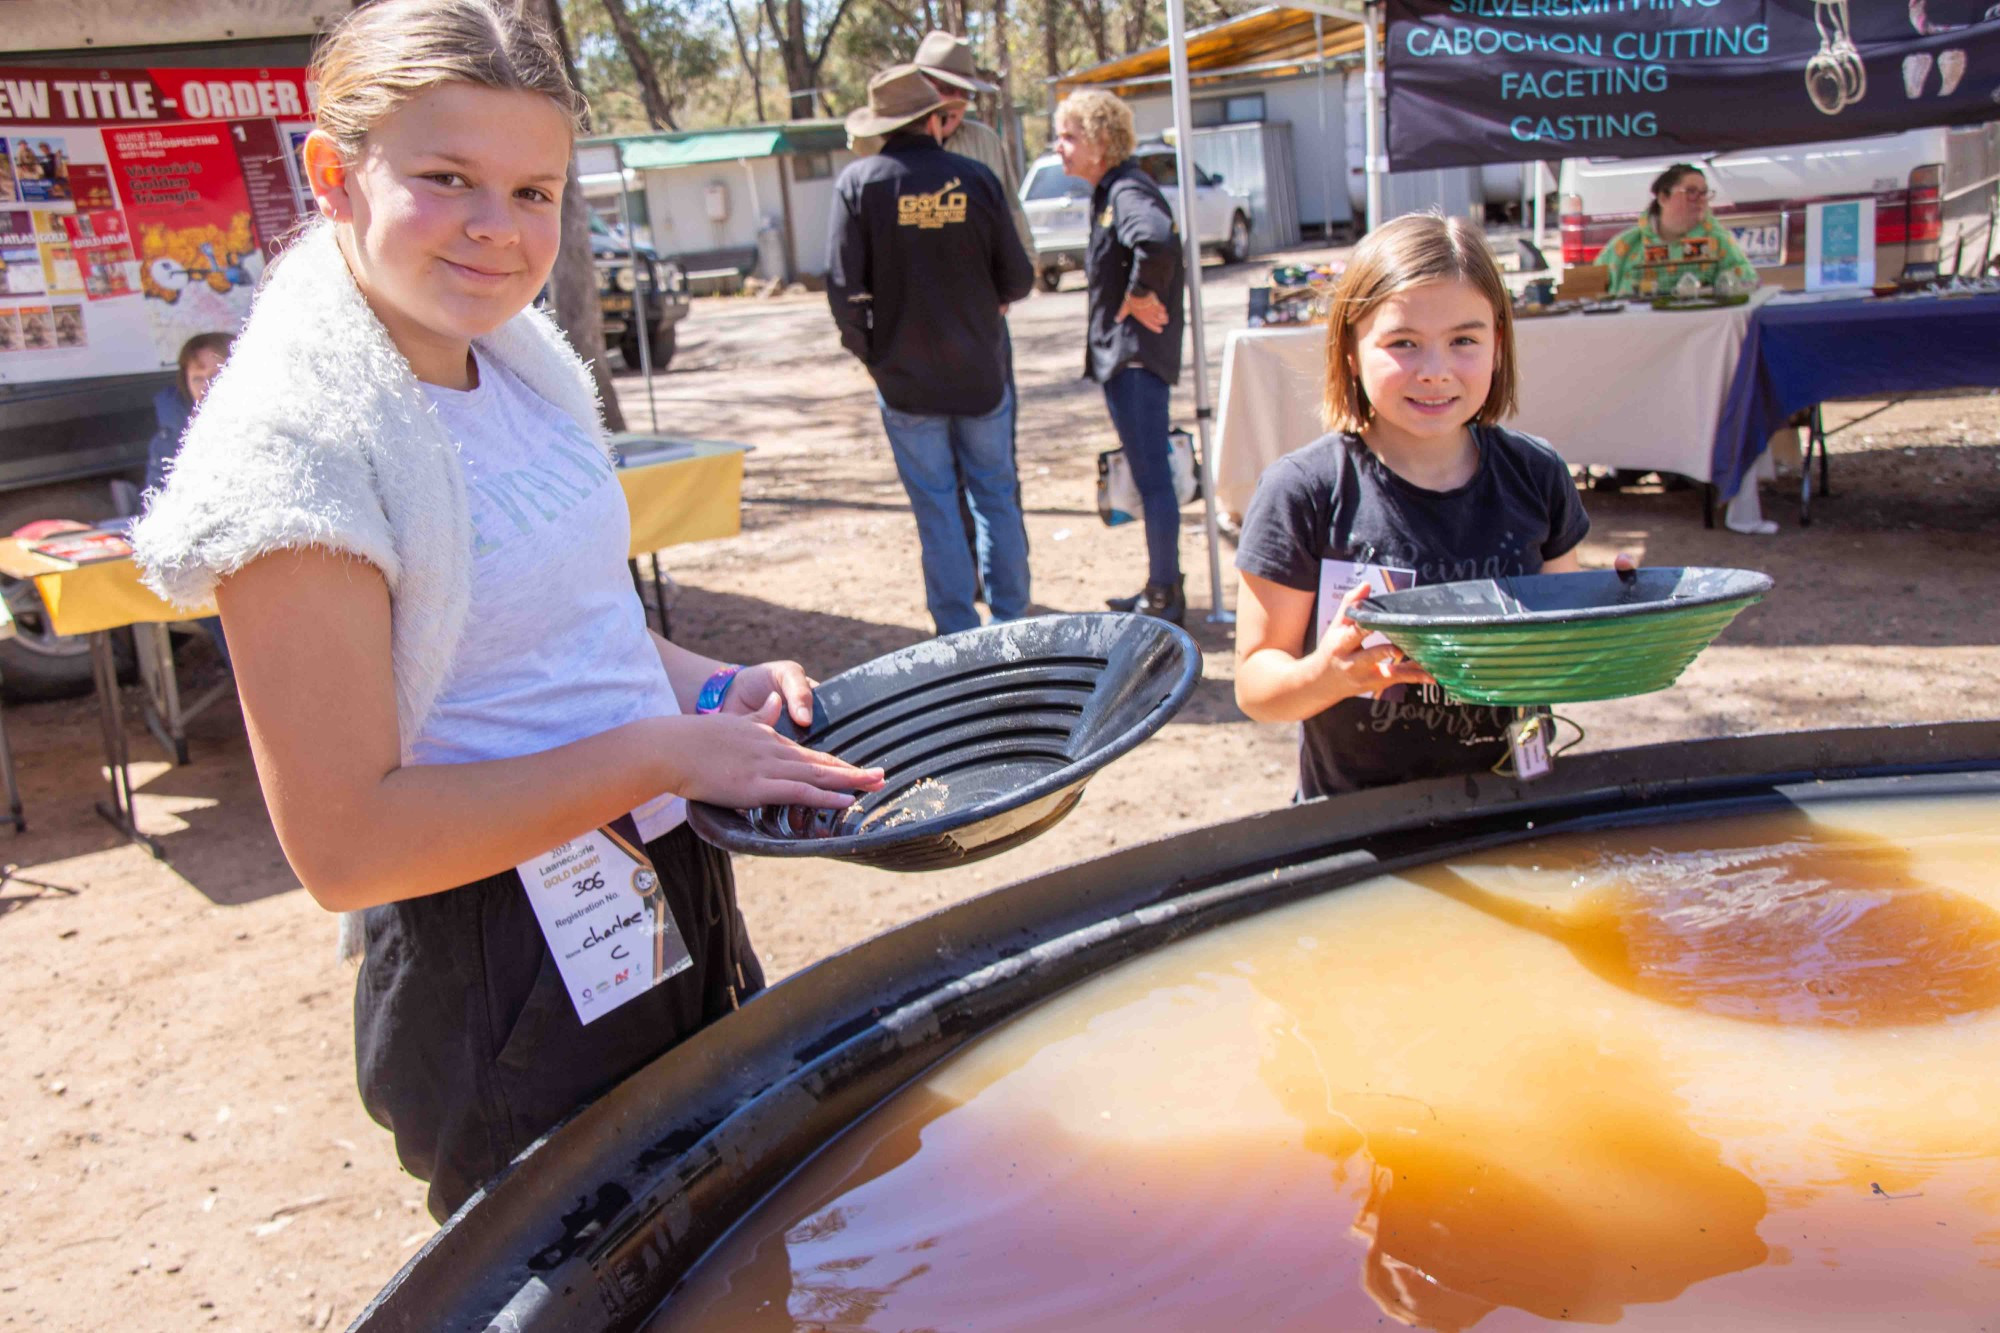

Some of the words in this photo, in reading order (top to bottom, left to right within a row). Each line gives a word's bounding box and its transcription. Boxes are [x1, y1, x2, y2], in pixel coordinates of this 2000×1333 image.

[1450, 0, 1721, 17] SILVERSMIT
[1406, 27, 1602, 57] CABOCHON
[1613, 24, 1769, 61] CUTTING
[1502, 65, 1667, 99] FACETING
[54, 81, 158, 119] TITLE
[182, 80, 302, 118] ORDER
[233, 125, 247, 142] 1
[1511, 112, 1657, 141] CASTING
[544, 870, 571, 889] GOLD
[572, 871, 605, 898] 306
[555, 897, 605, 928] Registration
